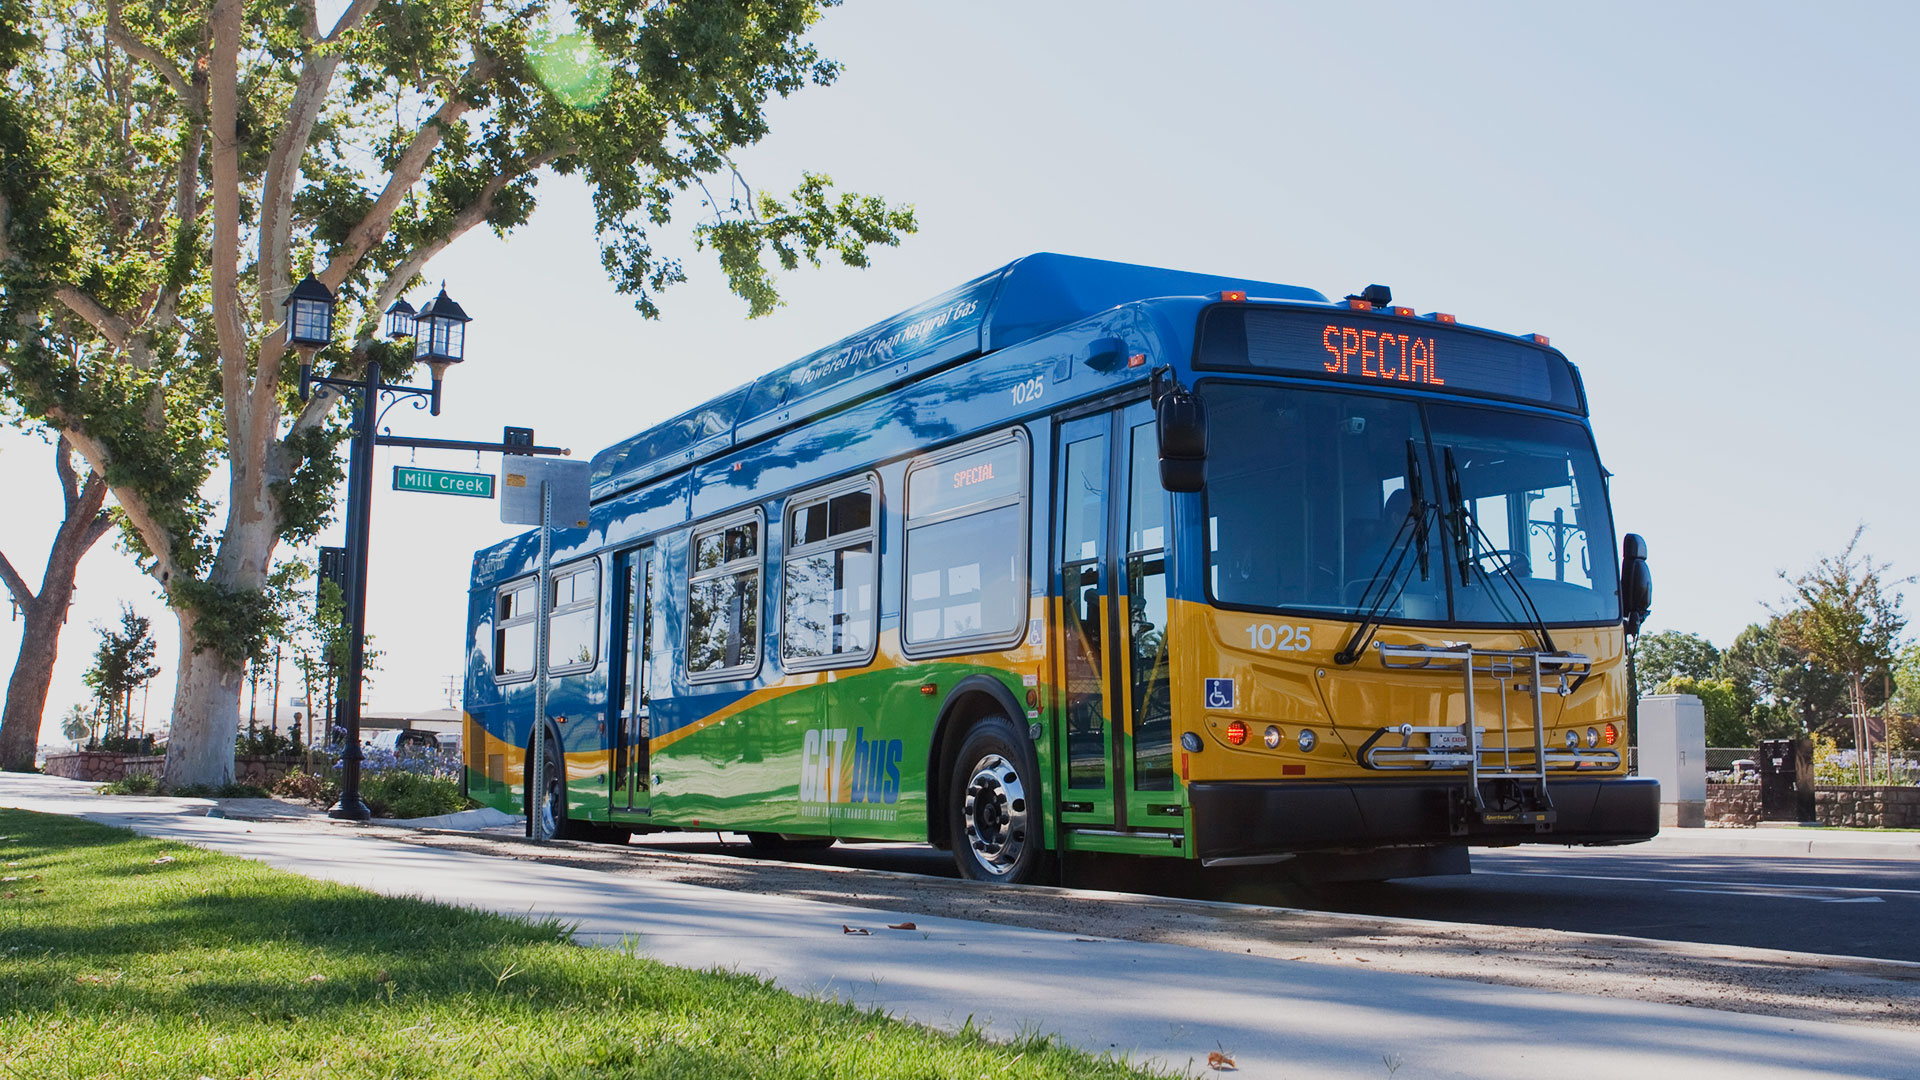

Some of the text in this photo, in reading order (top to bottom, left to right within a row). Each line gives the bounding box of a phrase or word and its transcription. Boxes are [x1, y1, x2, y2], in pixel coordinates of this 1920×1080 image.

[800, 300, 979, 386] Powered by Clean Natural Gas
[1323, 325, 1445, 385] SPECIAL
[1011, 375, 1044, 406] 1025
[404, 473, 484, 492] Mill Creek
[953, 463, 995, 489] SPECIAL
[1245, 623, 1312, 652] 1025
[800, 726, 903, 804] GET bus
